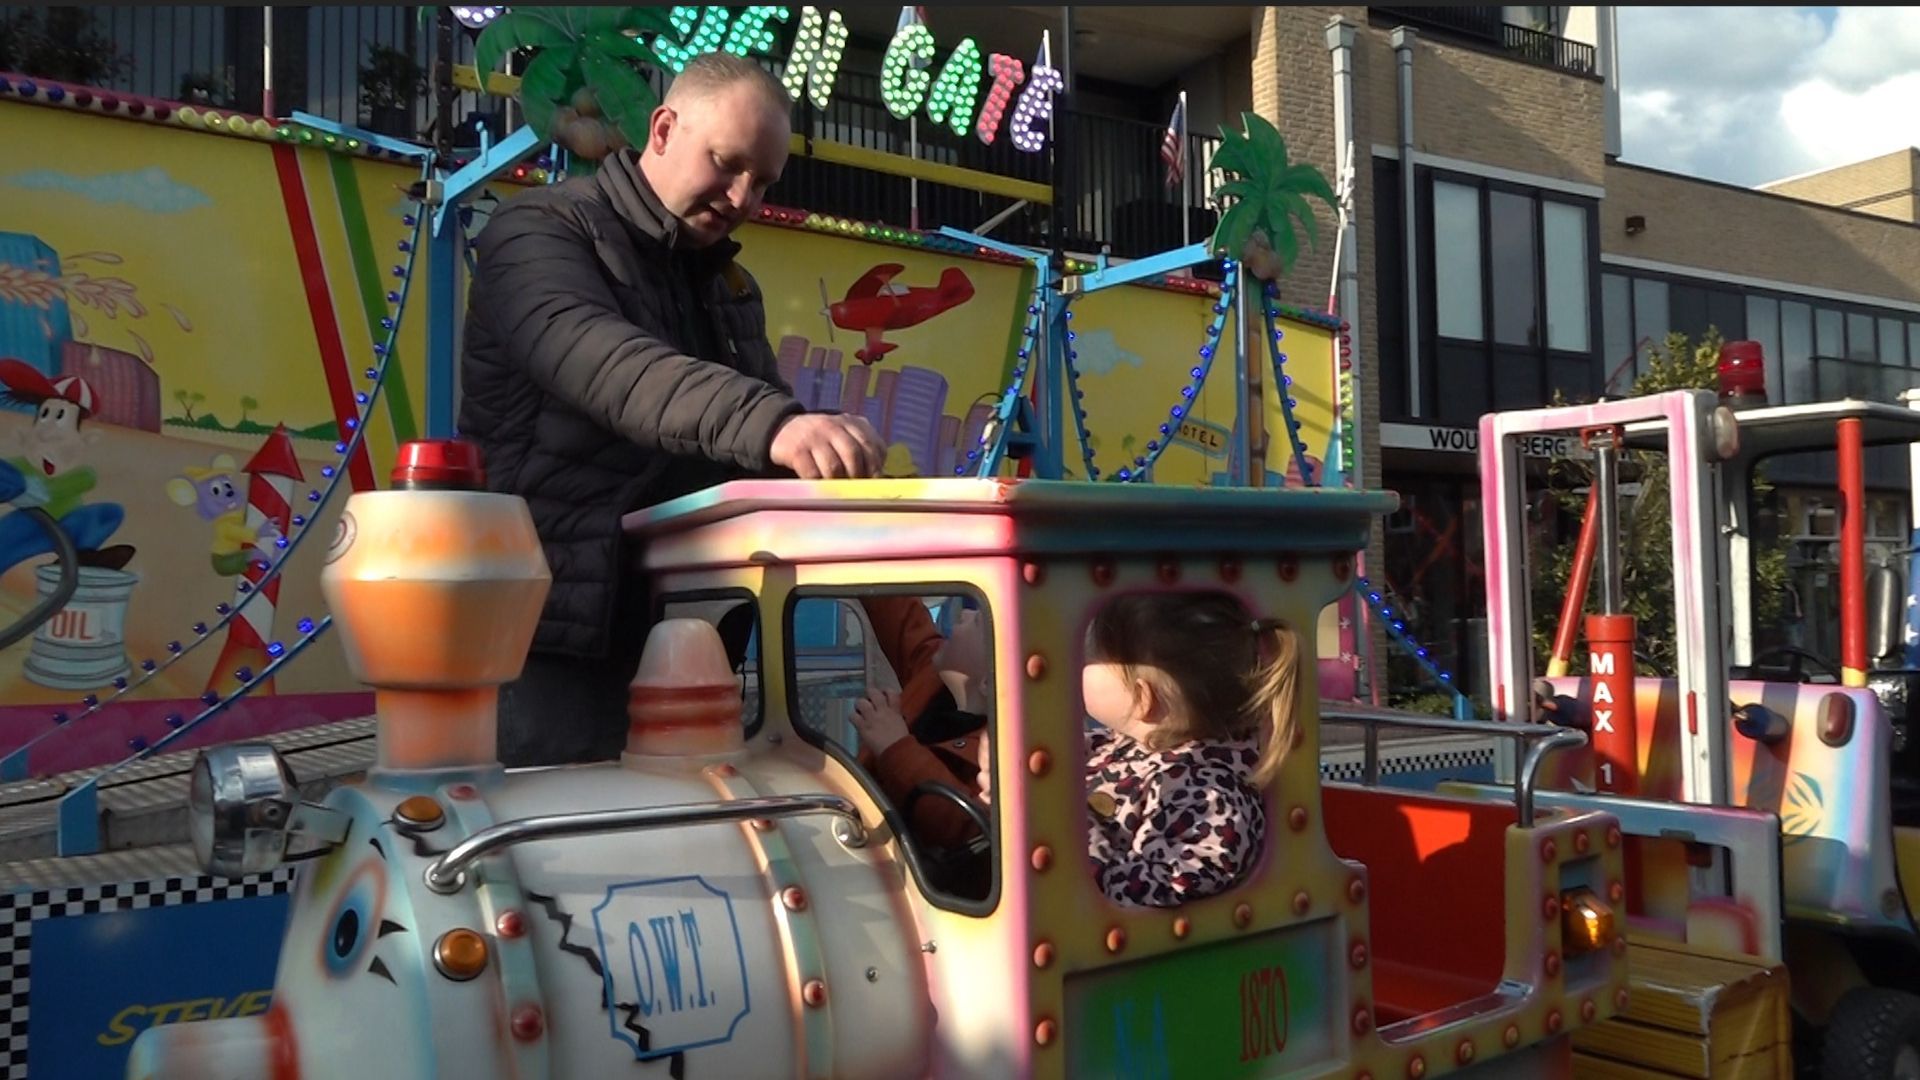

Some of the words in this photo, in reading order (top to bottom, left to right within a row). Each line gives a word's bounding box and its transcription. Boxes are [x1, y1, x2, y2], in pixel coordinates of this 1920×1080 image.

[881, 24, 1064, 152] GATE
[1179, 424, 1218, 448] OTEL
[51, 608, 94, 640] OIL
[1590, 652, 1615, 733] MAX
[1238, 965, 1290, 1062] 1870
